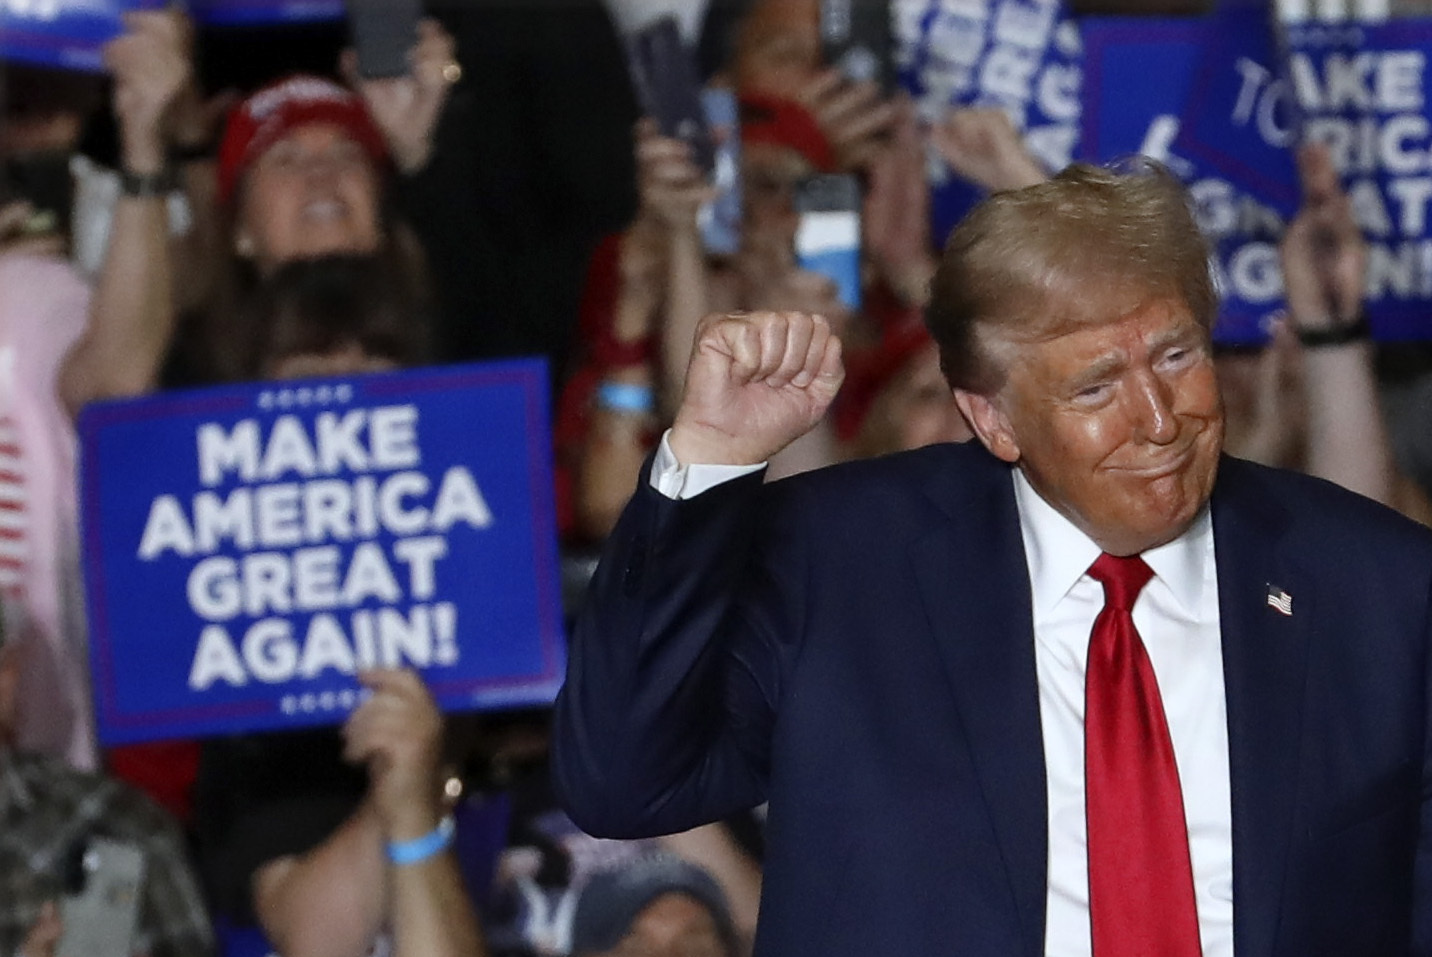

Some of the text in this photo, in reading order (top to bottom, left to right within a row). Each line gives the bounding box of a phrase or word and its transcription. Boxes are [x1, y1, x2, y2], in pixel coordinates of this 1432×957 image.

[196, 403, 421, 487] MAKE
[137, 465, 493, 562] AMERICA
[186, 534, 448, 622] GREAT
[188, 601, 459, 692] AGAIN!
